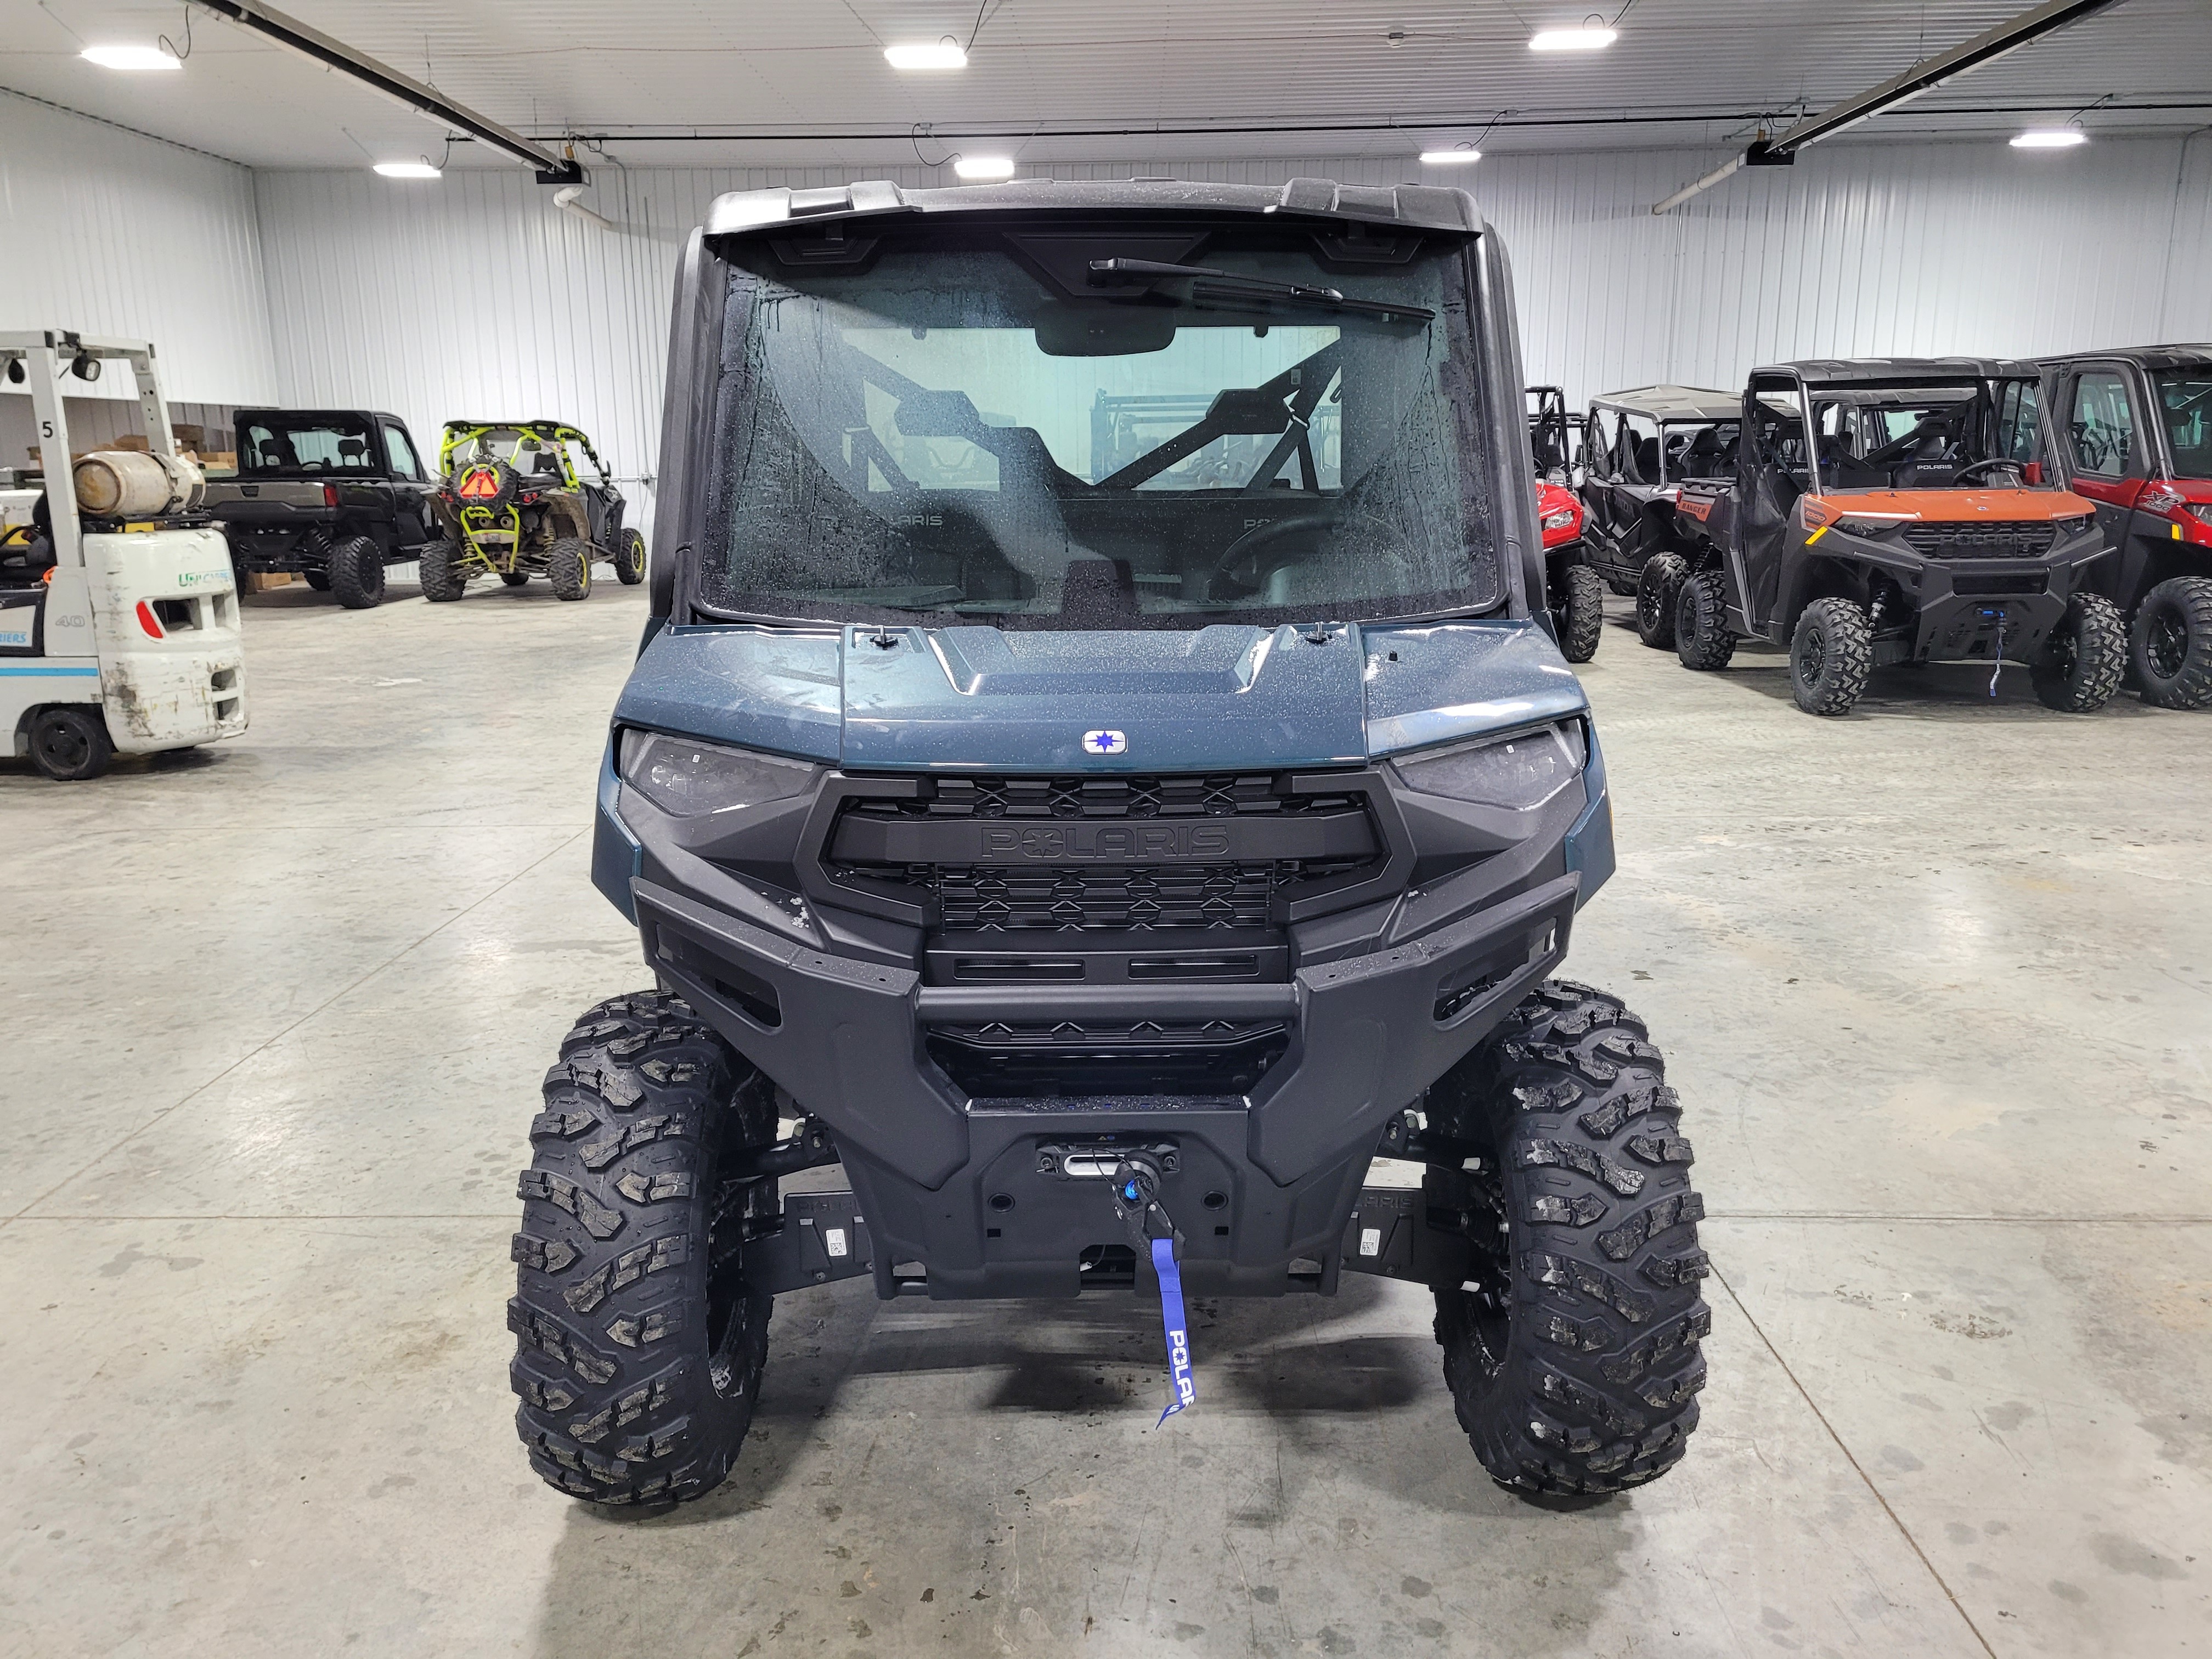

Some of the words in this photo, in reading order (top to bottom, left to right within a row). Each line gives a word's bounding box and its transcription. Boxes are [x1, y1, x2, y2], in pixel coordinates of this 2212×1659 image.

[43, 421, 53, 438] 5
[2142, 490, 2179, 504] XP
[1681, 503, 1707, 515] RANGER
[2147, 500, 2170, 511] 1000
[1805, 511, 1826, 521] 1000
[1939, 534, 2033, 545] POLARIS
[55, 615, 85, 627] 40
[981, 826, 1229, 858] POLARIS
